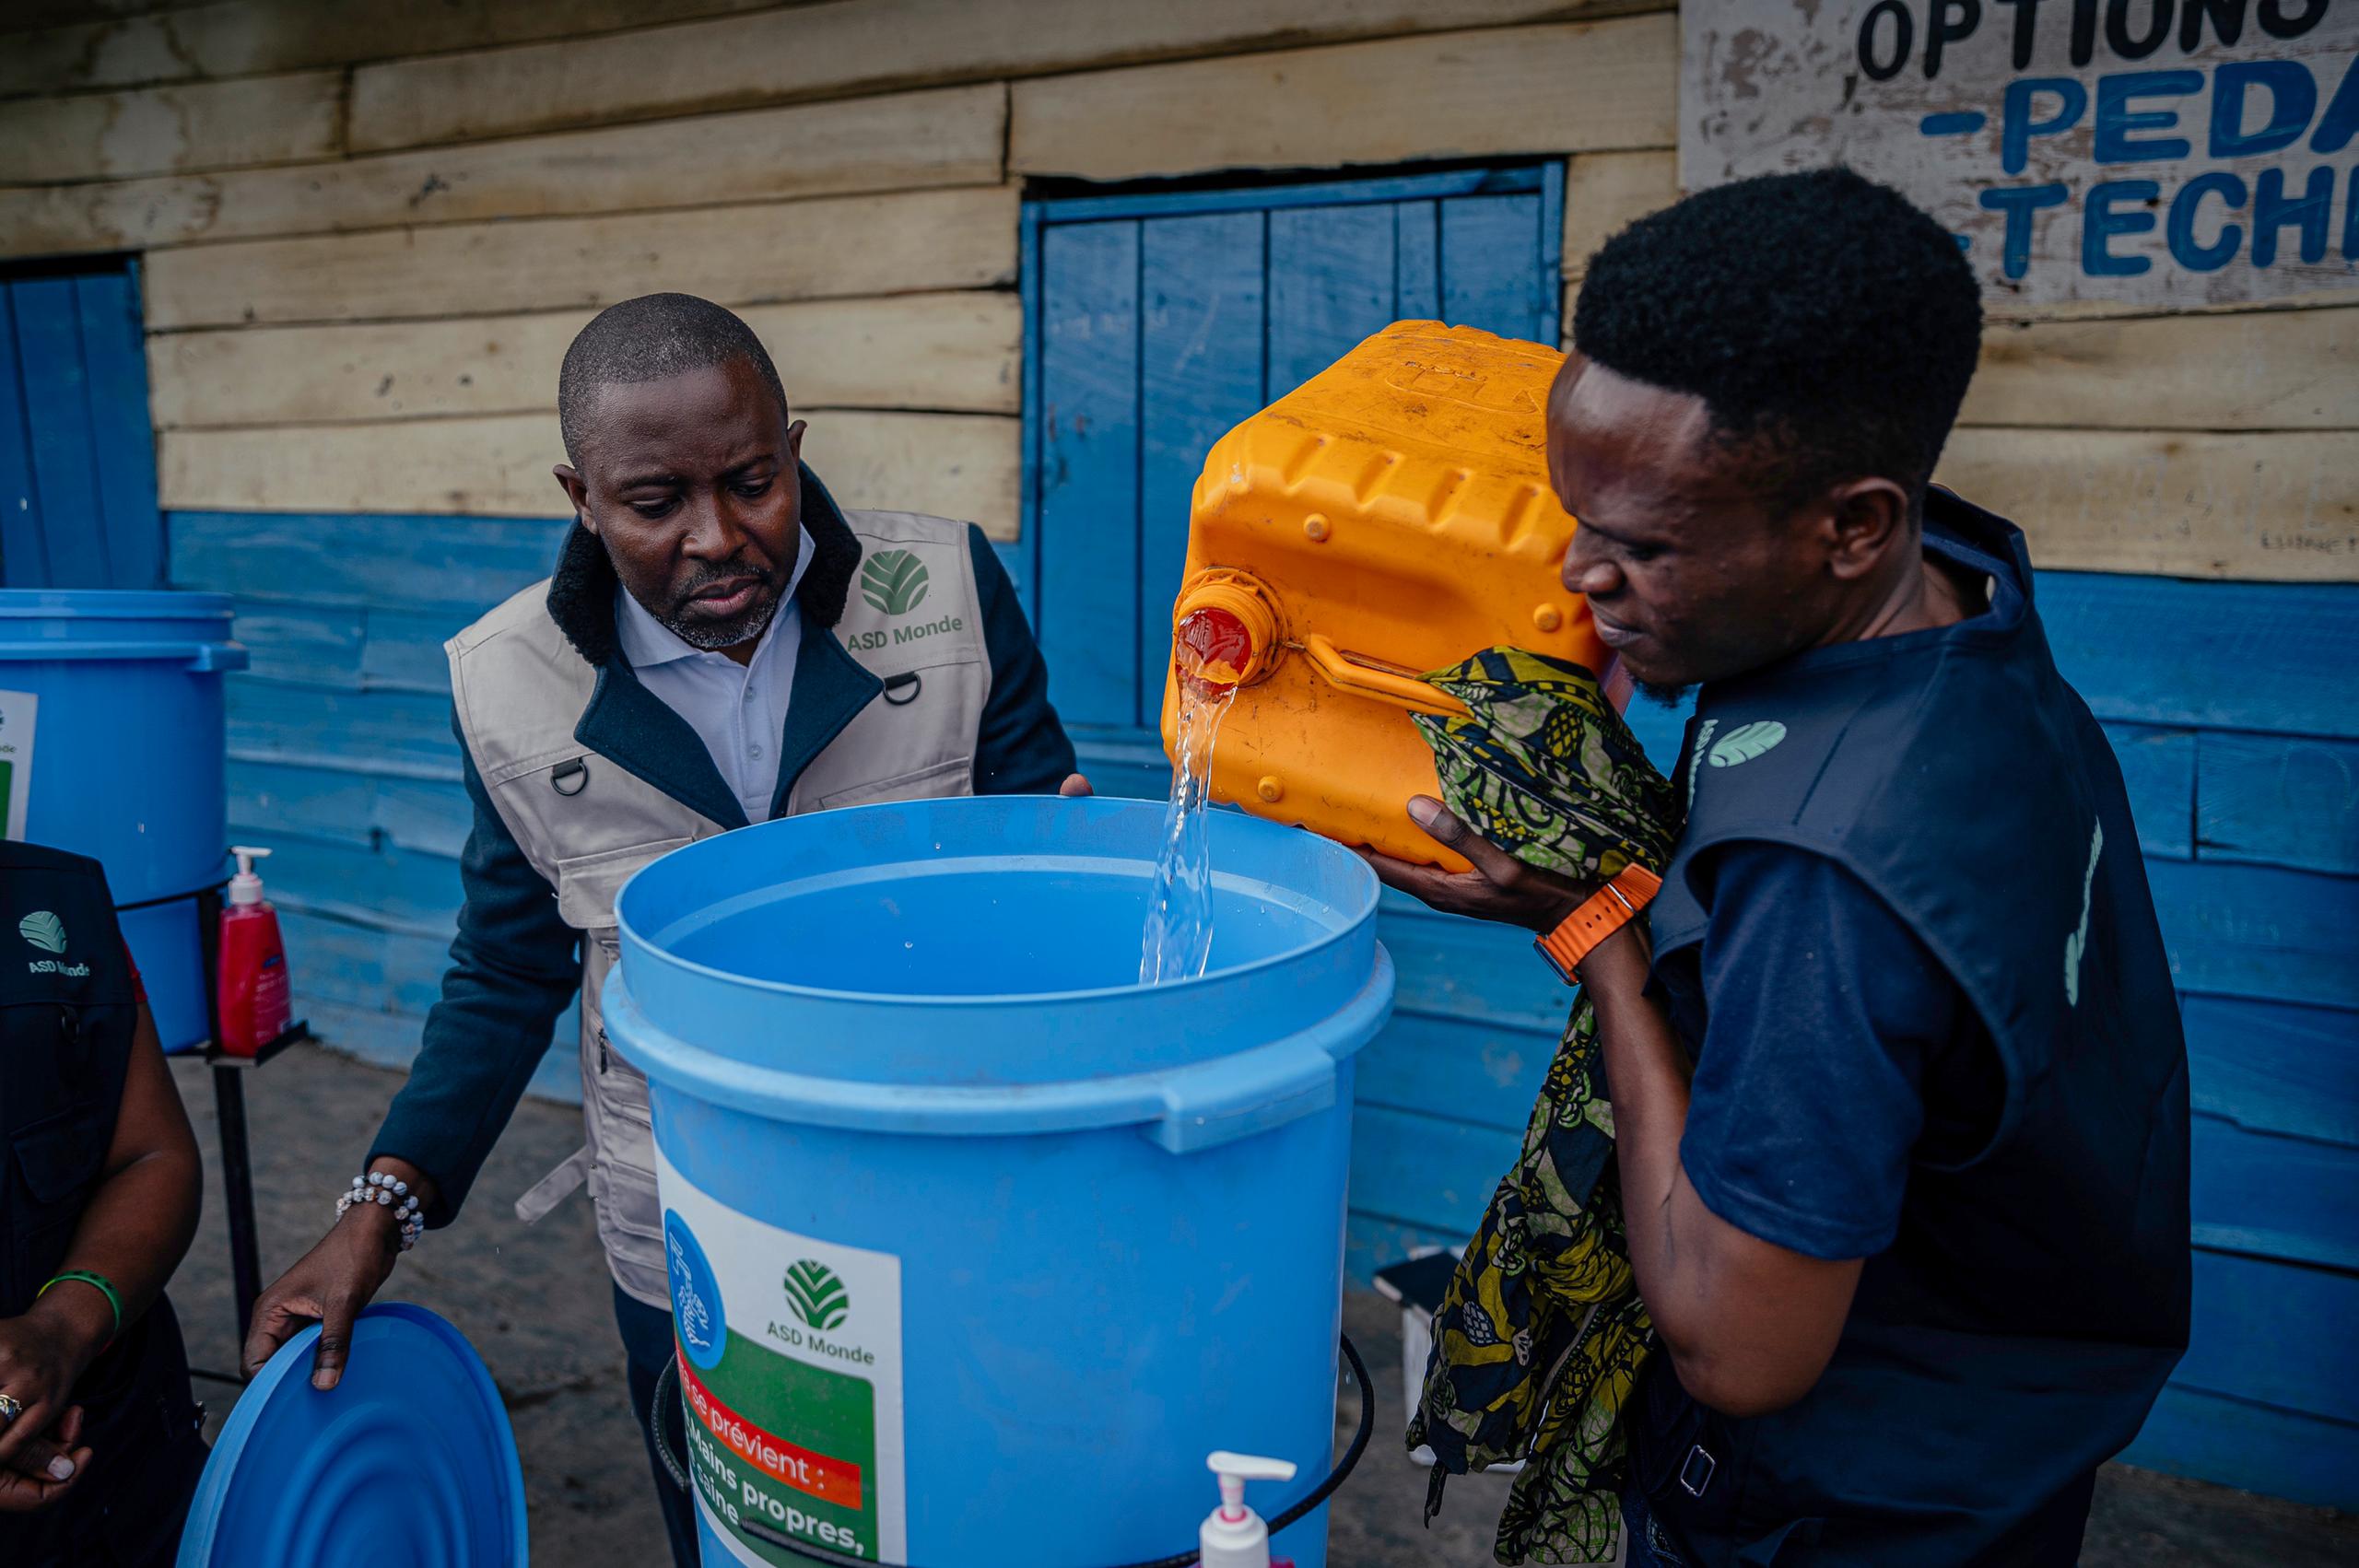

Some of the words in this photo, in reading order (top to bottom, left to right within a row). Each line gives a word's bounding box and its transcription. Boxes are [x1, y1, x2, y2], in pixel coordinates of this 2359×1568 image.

[847, 630, 888, 652] ASD
[892, 615, 963, 646] Monde
[29, 960, 56, 974] ASD
[768, 1320, 803, 1346] ASD
[808, 1333, 874, 1365] Monde
[710, 1407, 811, 1485] prévient
[690, 1416, 738, 1491] Mains
[741, 1479, 865, 1557] propres,
[697, 1464, 739, 1526] saine
